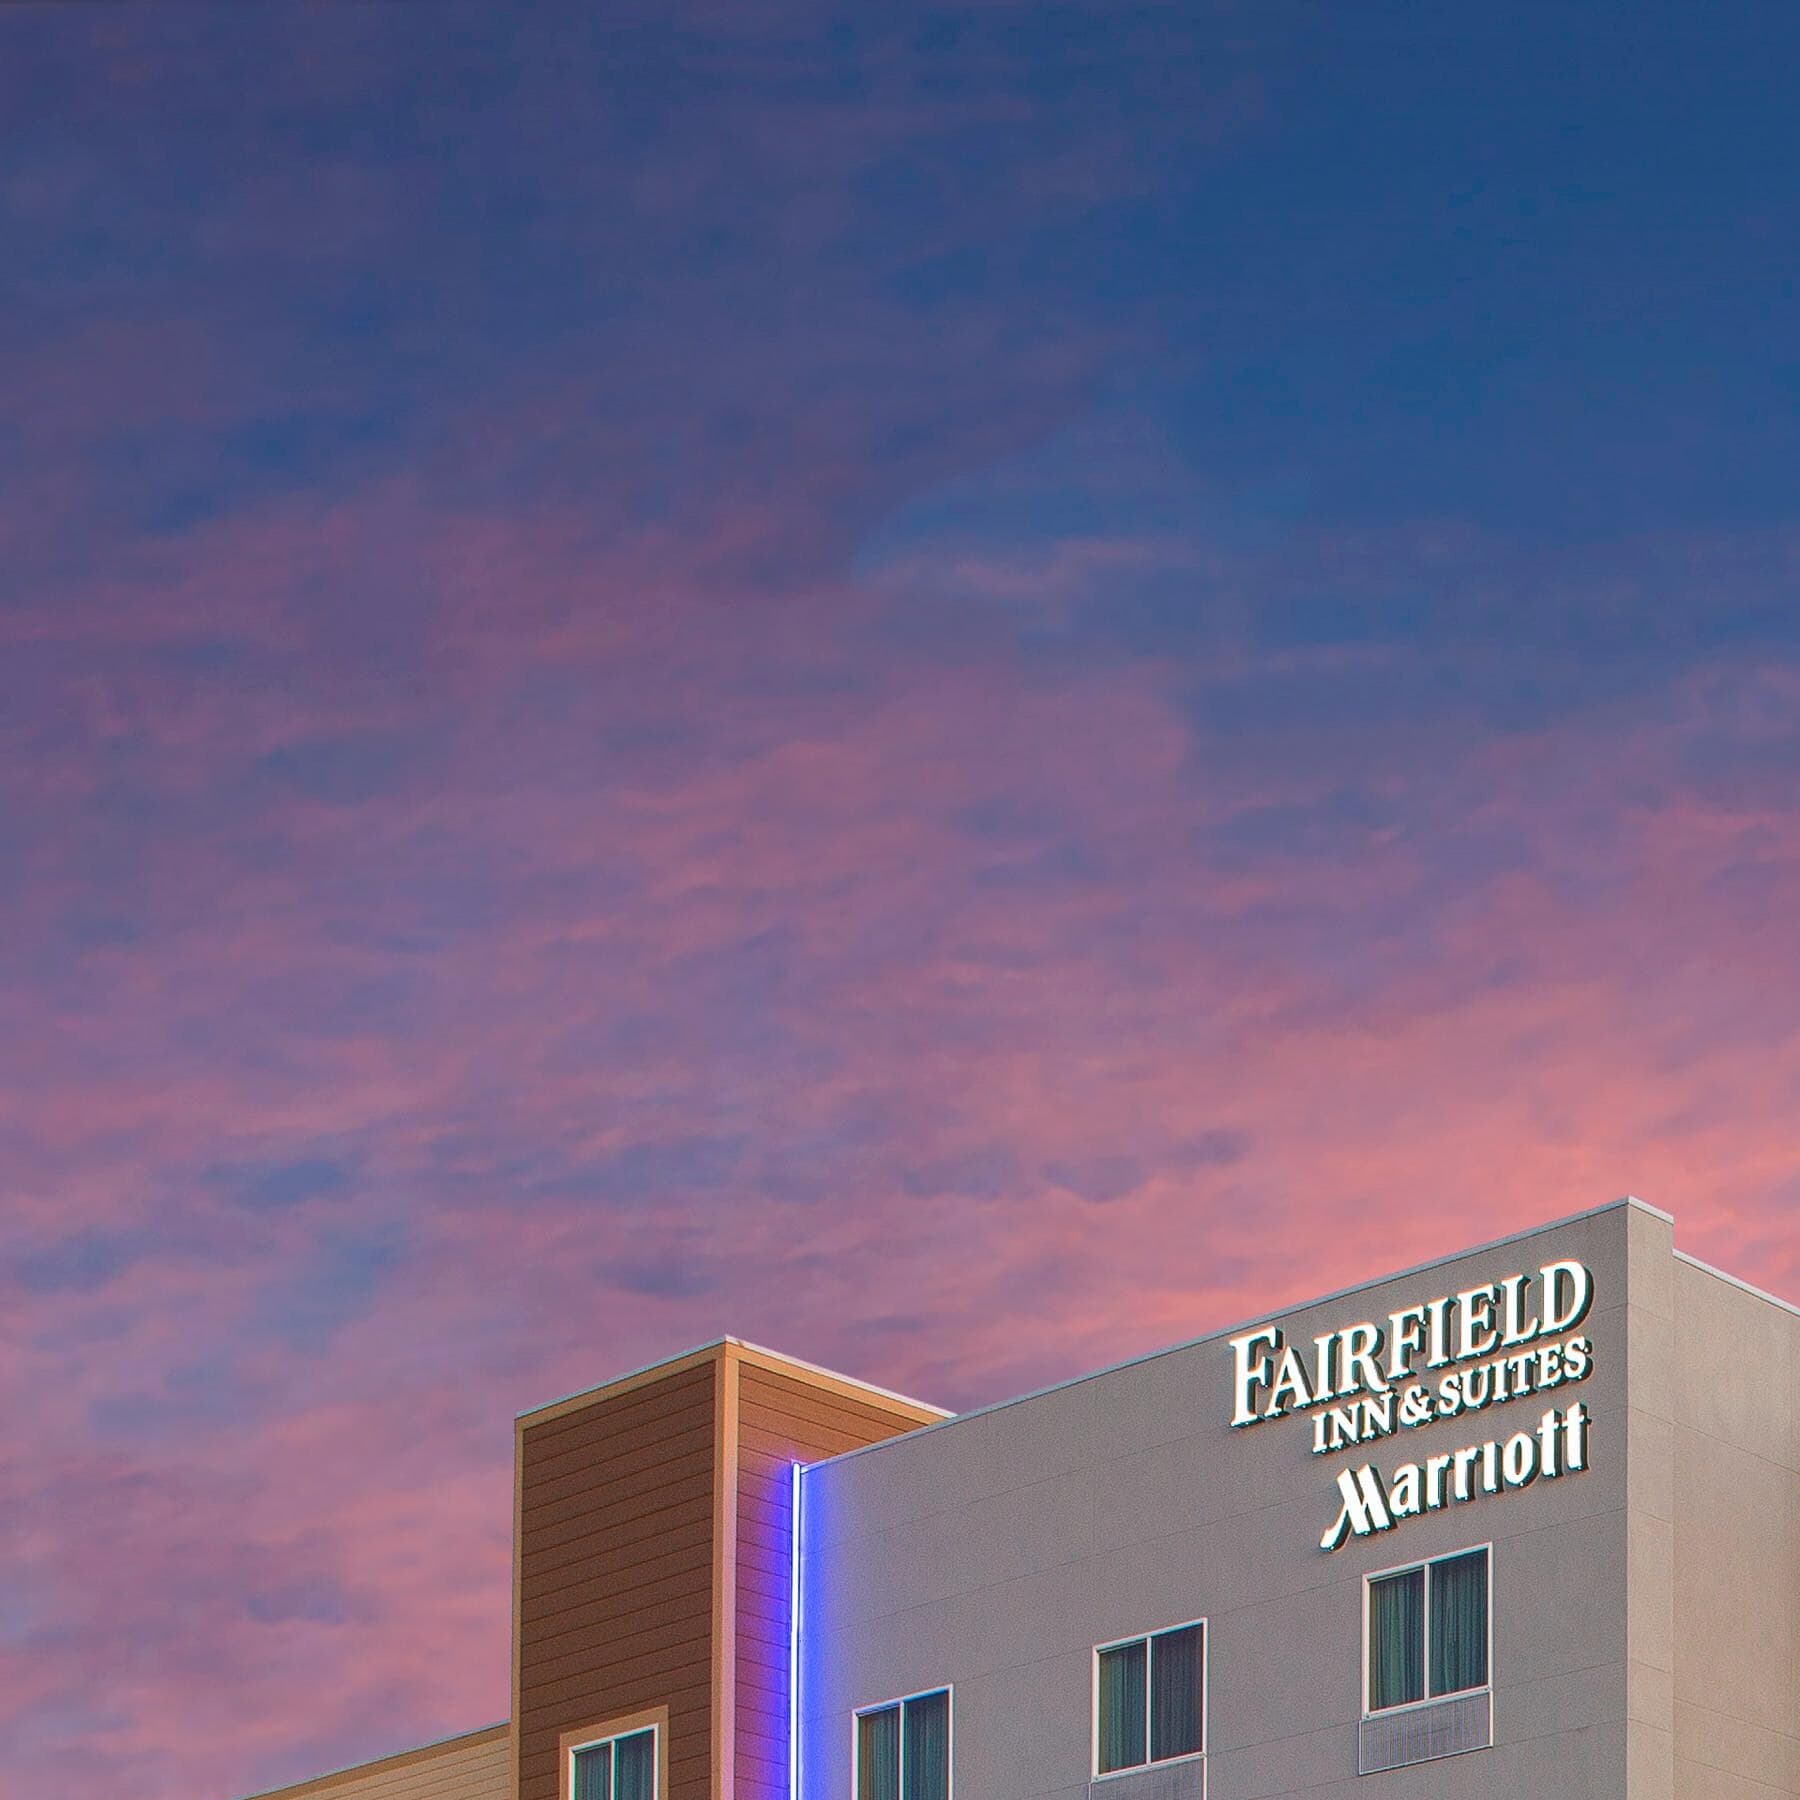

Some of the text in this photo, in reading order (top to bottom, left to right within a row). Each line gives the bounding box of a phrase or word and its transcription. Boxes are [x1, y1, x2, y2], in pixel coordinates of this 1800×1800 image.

[1229, 1259, 1595, 1427] FAIRFIELD
[1438, 1335, 1594, 1417] SUITES
[1319, 1401, 1593, 1552] Marriott
